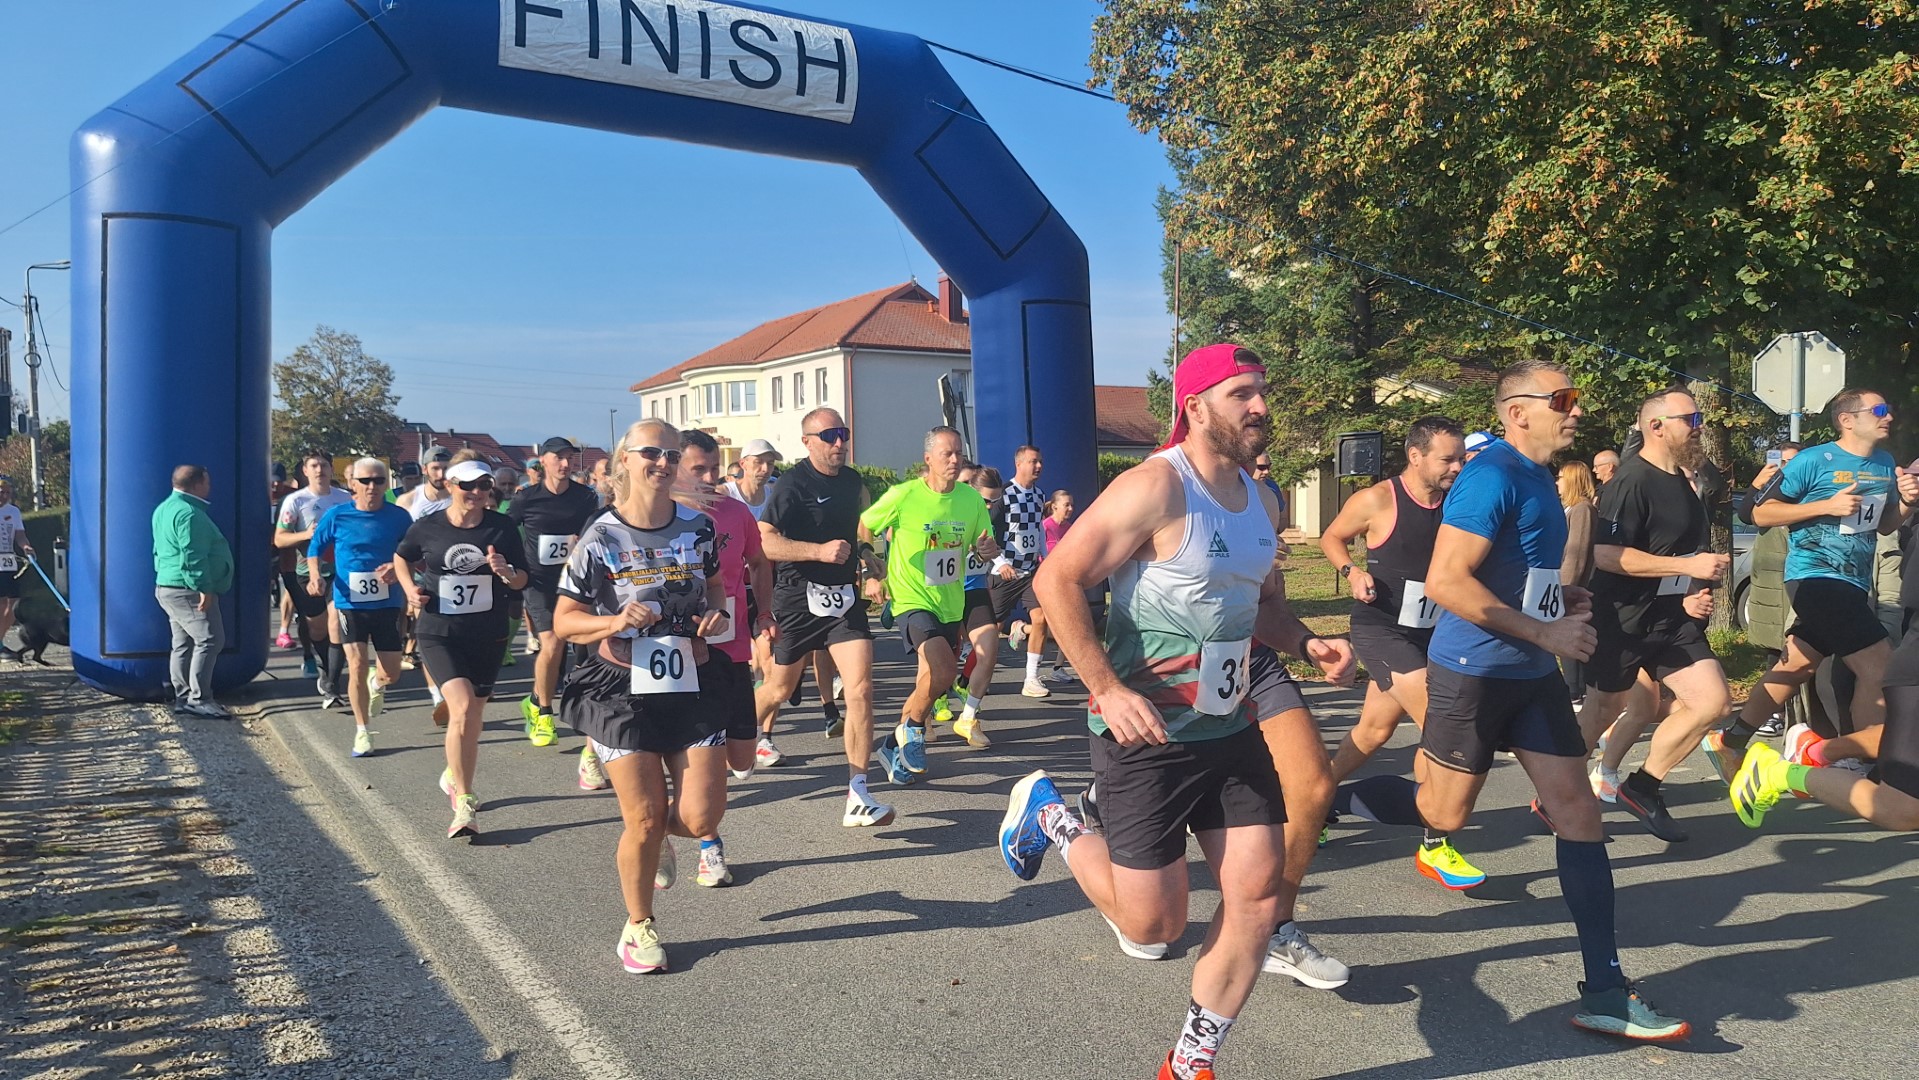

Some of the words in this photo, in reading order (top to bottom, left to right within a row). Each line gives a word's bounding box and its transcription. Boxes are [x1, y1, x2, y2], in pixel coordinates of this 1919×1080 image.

[513, 0, 848, 105] FINISH
[1857, 503, 1875, 526] 14
[549, 542, 569, 559] 25
[1021, 535, 1036, 549] 83
[2, 557, 14, 568] 29
[936, 557, 956, 578] 16
[359, 578, 379, 595] 38
[452, 584, 479, 606] 37
[820, 591, 844, 609] 39
[1538, 583, 1560, 618] 48
[649, 648, 684, 680] 60
